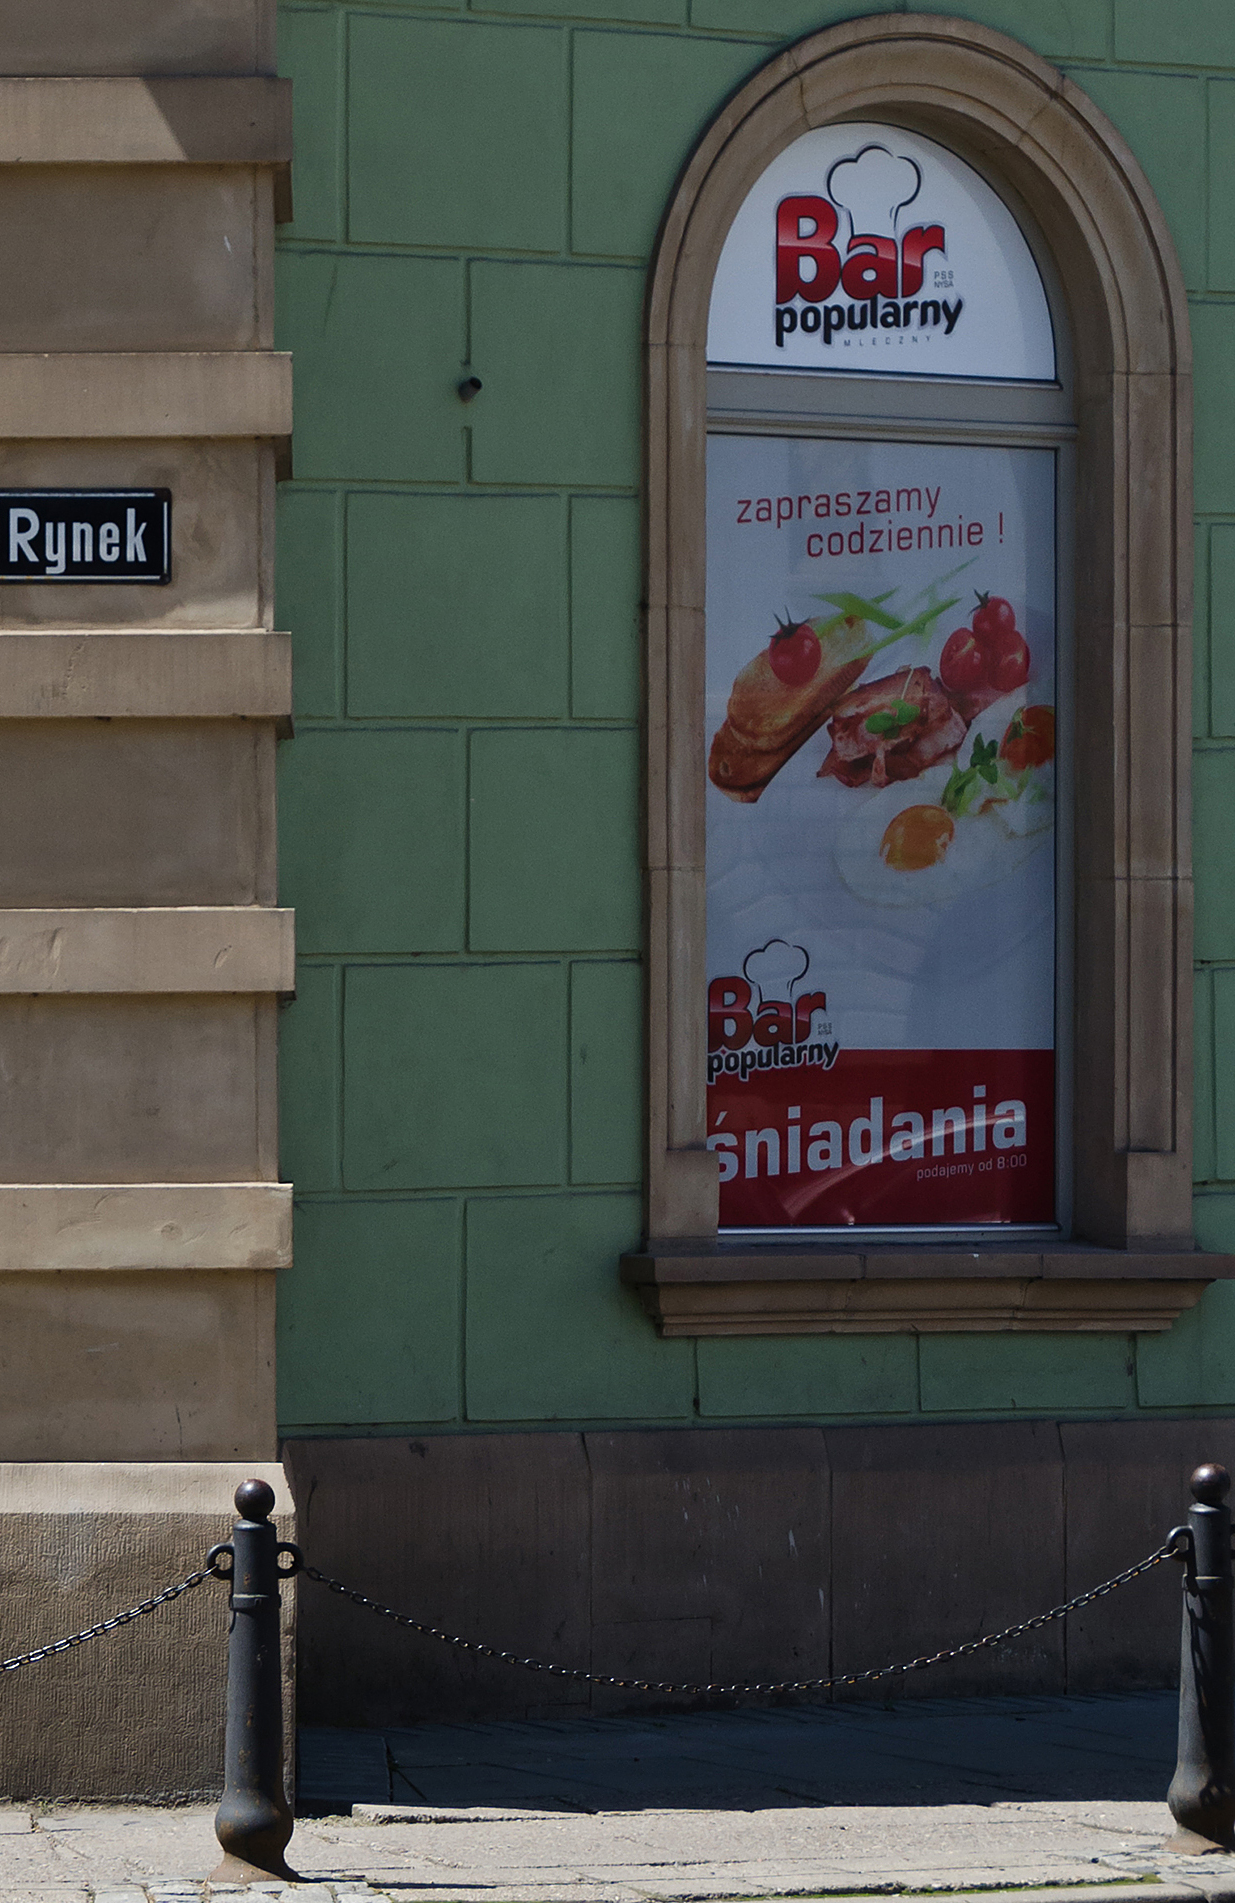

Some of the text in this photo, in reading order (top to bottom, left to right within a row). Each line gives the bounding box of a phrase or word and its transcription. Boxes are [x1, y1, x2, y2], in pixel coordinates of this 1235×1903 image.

[775, 195, 946, 304] Bar
[933, 270, 954, 280] PSS
[933, 280, 954, 289] NYSA
[775, 296, 963, 348] popularny
[736, 485, 942, 529] zapraszamy
[8, 507, 148, 575] Rynek
[806, 515, 985, 558] codziennie
[707, 975, 827, 1053] Bar
[706, 1041, 840, 1084] popularny
[706, 1084, 1027, 1183] śniadania
[916, 1153, 1027, 1182] podajemy od 8:00
